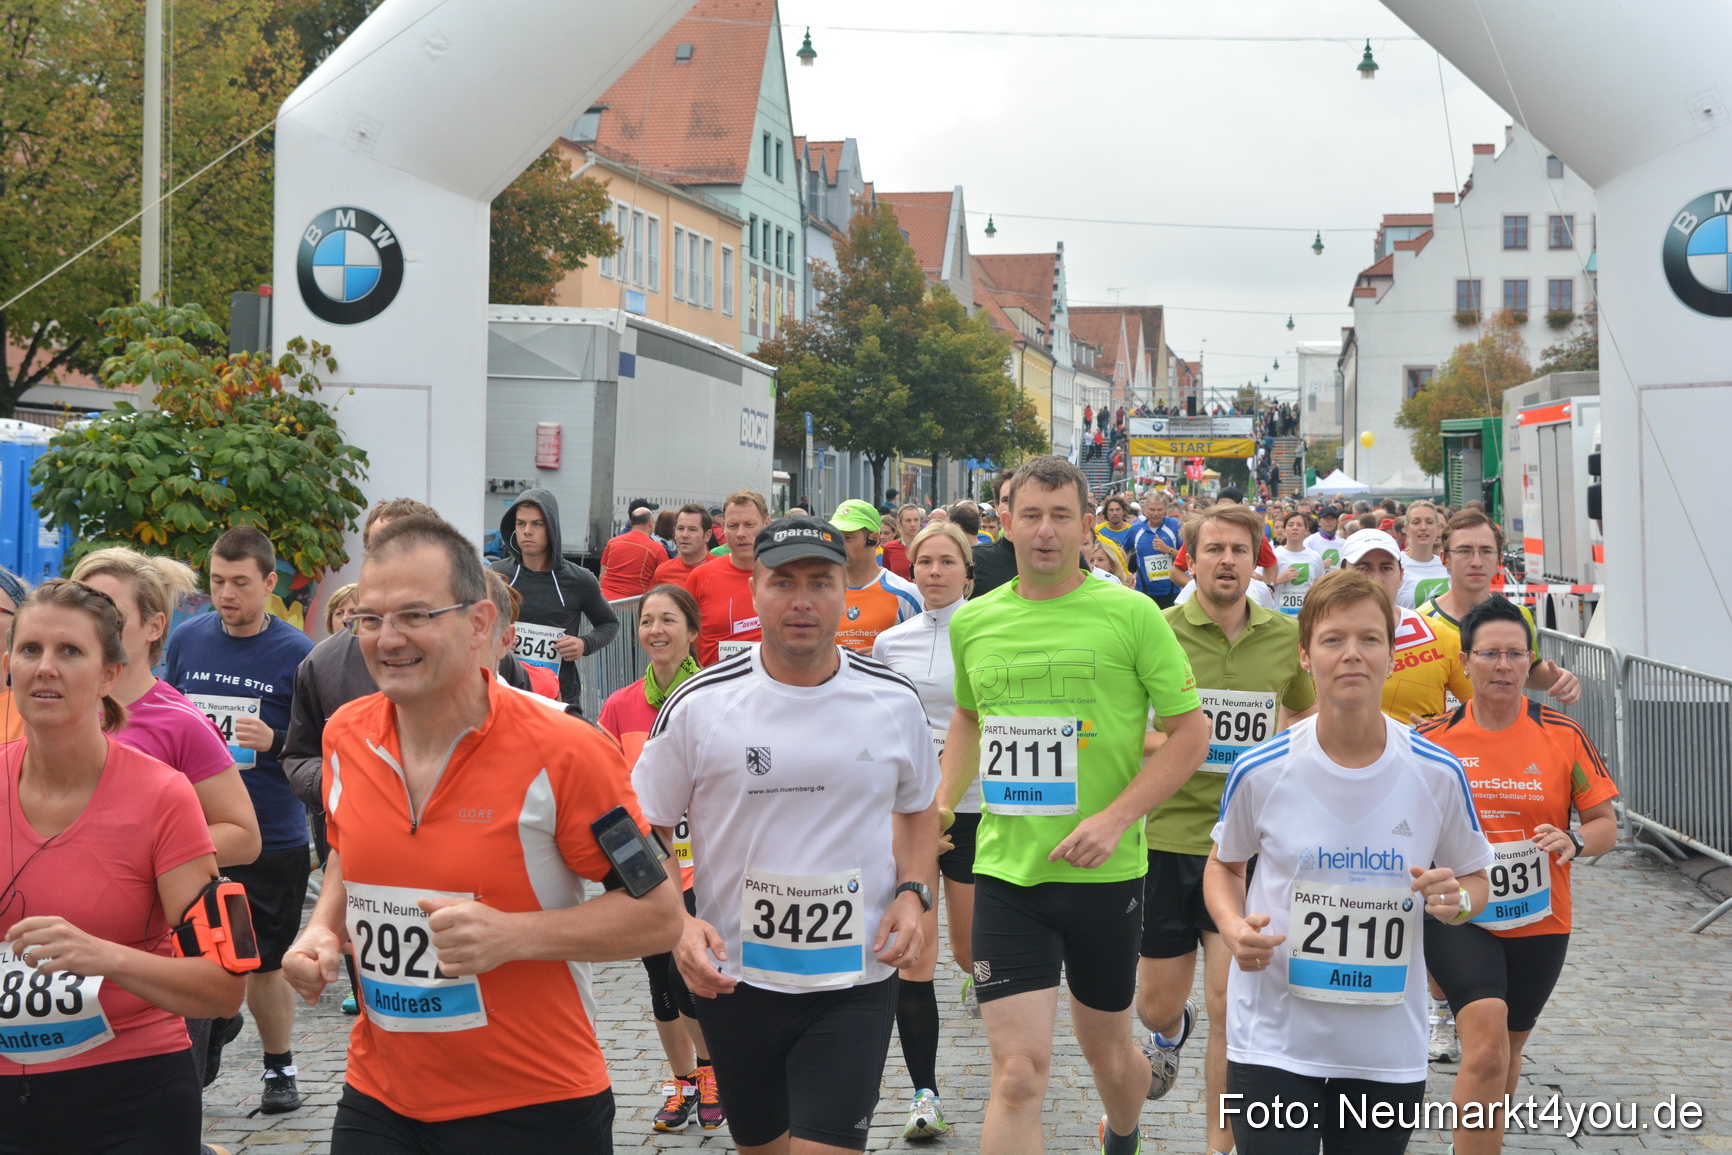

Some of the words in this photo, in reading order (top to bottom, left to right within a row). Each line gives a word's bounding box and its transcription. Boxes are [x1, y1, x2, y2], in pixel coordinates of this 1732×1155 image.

[304, 209, 395, 249] BMW
[740, 407, 768, 450] BOCK
[1170, 442, 1213, 453] START
[774, 528, 819, 541] mares
[1151, 560, 1168, 571] 332
[1283, 596, 1302, 607] 205
[528, 629, 555, 637] Neumarkt
[514, 635, 557, 660] 2543
[1393, 648, 1445, 672] BÖGL
[186, 671, 190, 679] I
[192, 672, 210, 680] AM
[214, 673, 240, 685] THE
[244, 678, 274, 693] STIG
[208, 703, 245, 711] Neumarkt
[1222, 699, 1263, 708] Neumarkt
[984, 726, 1008, 735] PARTL
[1010, 726, 1057, 736] Neumarkt
[988, 740, 1062, 776] 2111
[748, 785, 825, 795] www.sun.nuernberg.de
[1004, 787, 1042, 802] Armin
[459, 808, 494, 818] GORE
[1318, 846, 1403, 870] heinloth
[1494, 846, 1537, 860] Neumarkt
[745, 879, 783, 896] PARTL
[787, 884, 844, 897] Neumarkt
[349, 895, 379, 914] PARTL
[1294, 892, 1336, 907] PARTL
[1340, 898, 1398, 911] Neumarkt
[1495, 902, 1529, 919] Birgit
[753, 899, 853, 943] 3422
[1302, 911, 1405, 960] 2110
[1329, 969, 1372, 988] Anita
[375, 988, 442, 1014] Andreas
